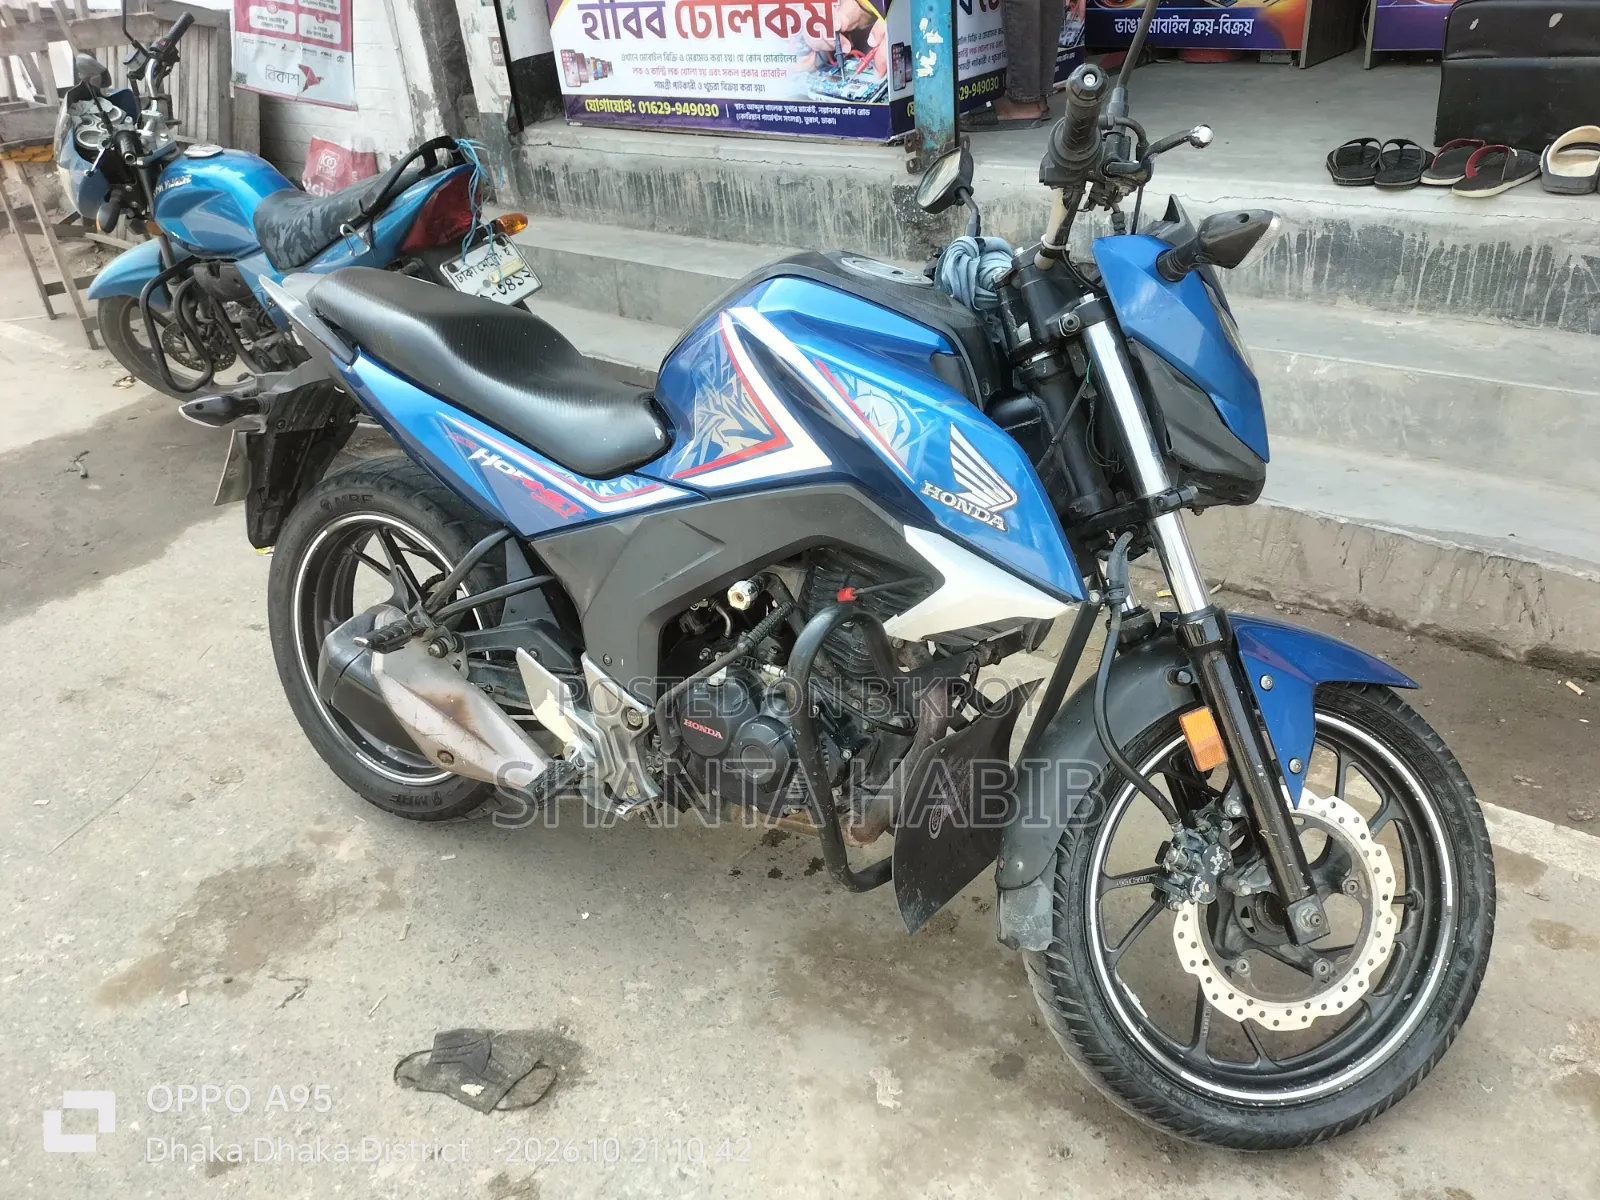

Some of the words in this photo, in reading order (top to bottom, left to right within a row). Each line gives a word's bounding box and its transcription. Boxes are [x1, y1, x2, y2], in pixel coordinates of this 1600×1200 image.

[265, 64, 300, 86] বিকাশ
[959, 76, 1000, 101] 29-949030
[638, 100, 719, 117] 01629-949030
[920, 480, 1008, 532] HONDA
[683, 718, 724, 740] HONDA
